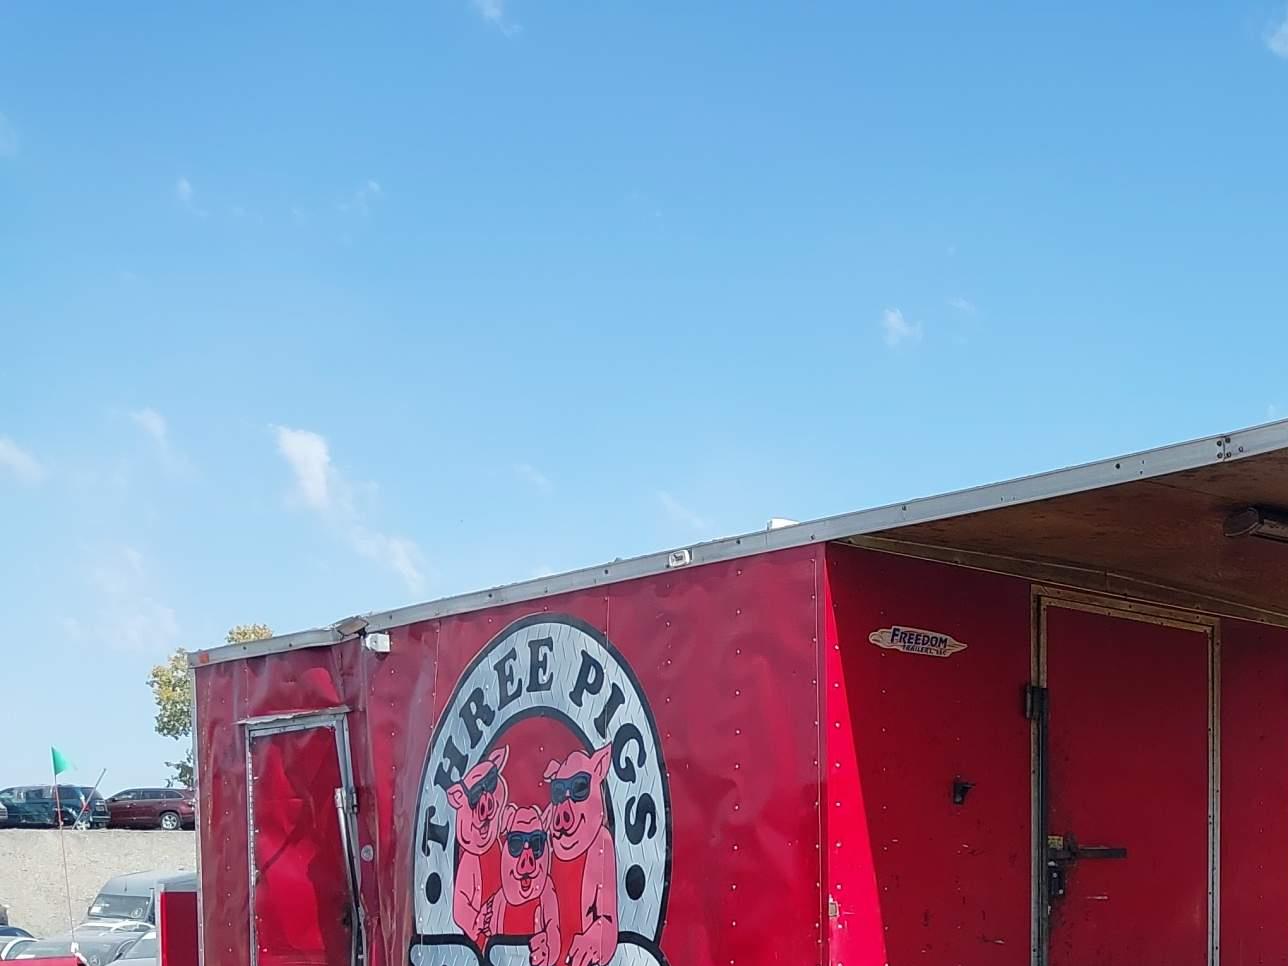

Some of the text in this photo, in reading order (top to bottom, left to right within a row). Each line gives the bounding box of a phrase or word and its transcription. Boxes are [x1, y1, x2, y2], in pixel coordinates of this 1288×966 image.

[890, 627, 948, 649] FREEDOM
[421, 636, 659, 858] THREE PIGS
